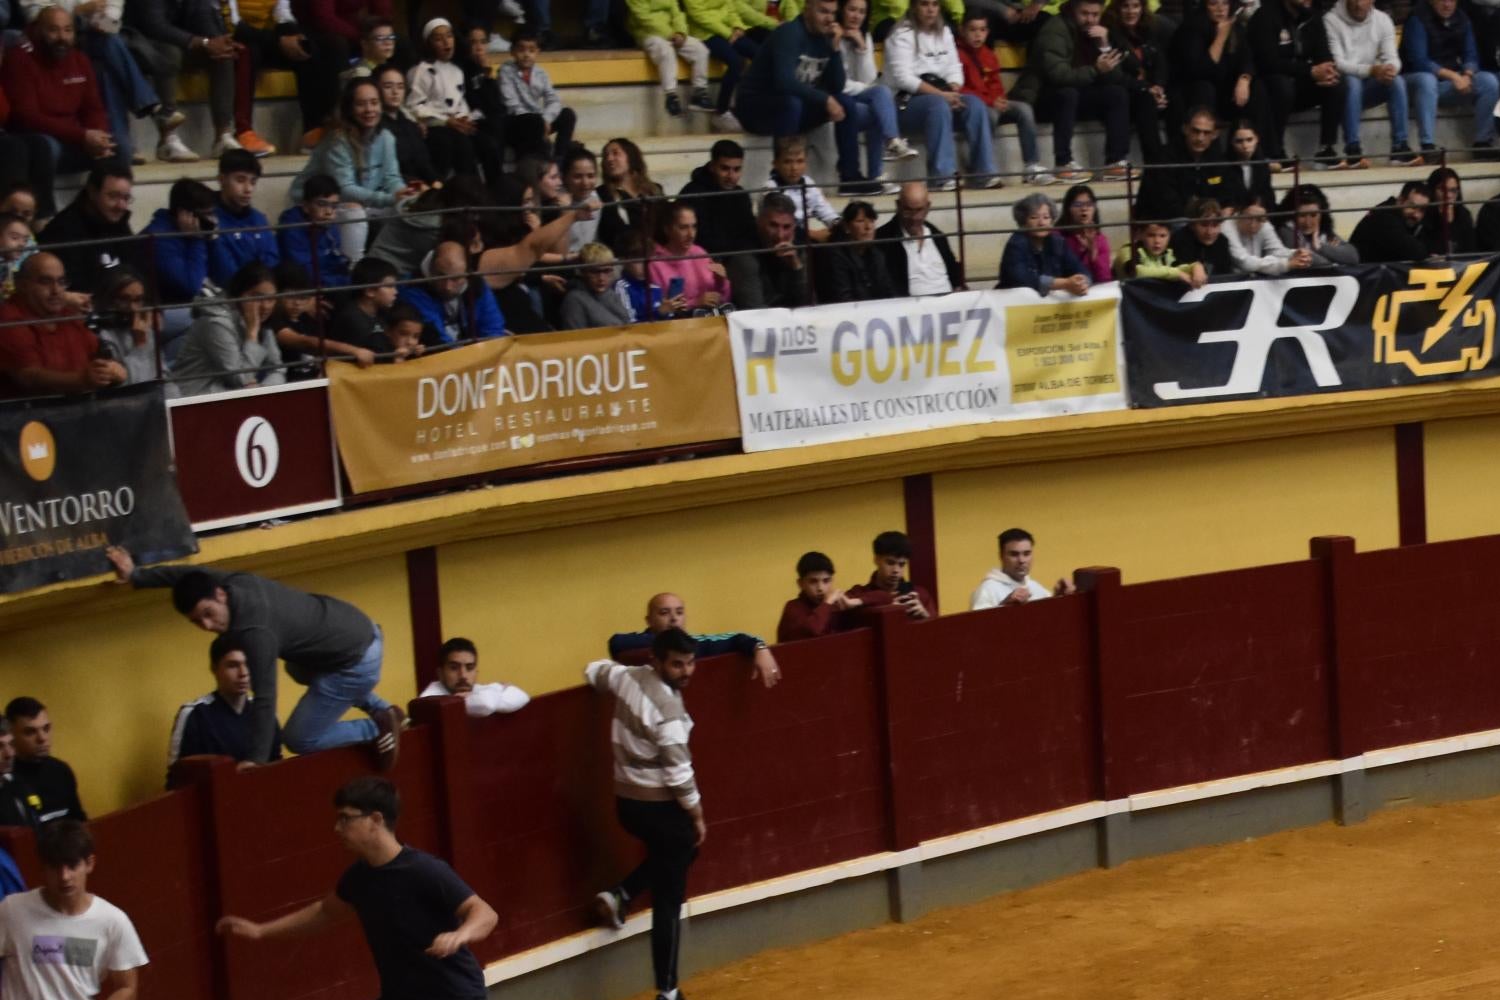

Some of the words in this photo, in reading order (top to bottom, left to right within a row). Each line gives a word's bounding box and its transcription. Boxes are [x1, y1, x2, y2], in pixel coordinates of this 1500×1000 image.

[830, 307, 997, 388] GOMEZ
[416, 421, 479, 444] HOTEL
[749, 403, 848, 433] MATERIALES
[852, 400, 871, 423] DE
[876, 384, 999, 420] CONSTRUCCIÓN
[247, 420, 267, 482] 6
[0, 486, 135, 537] VENTORRO
